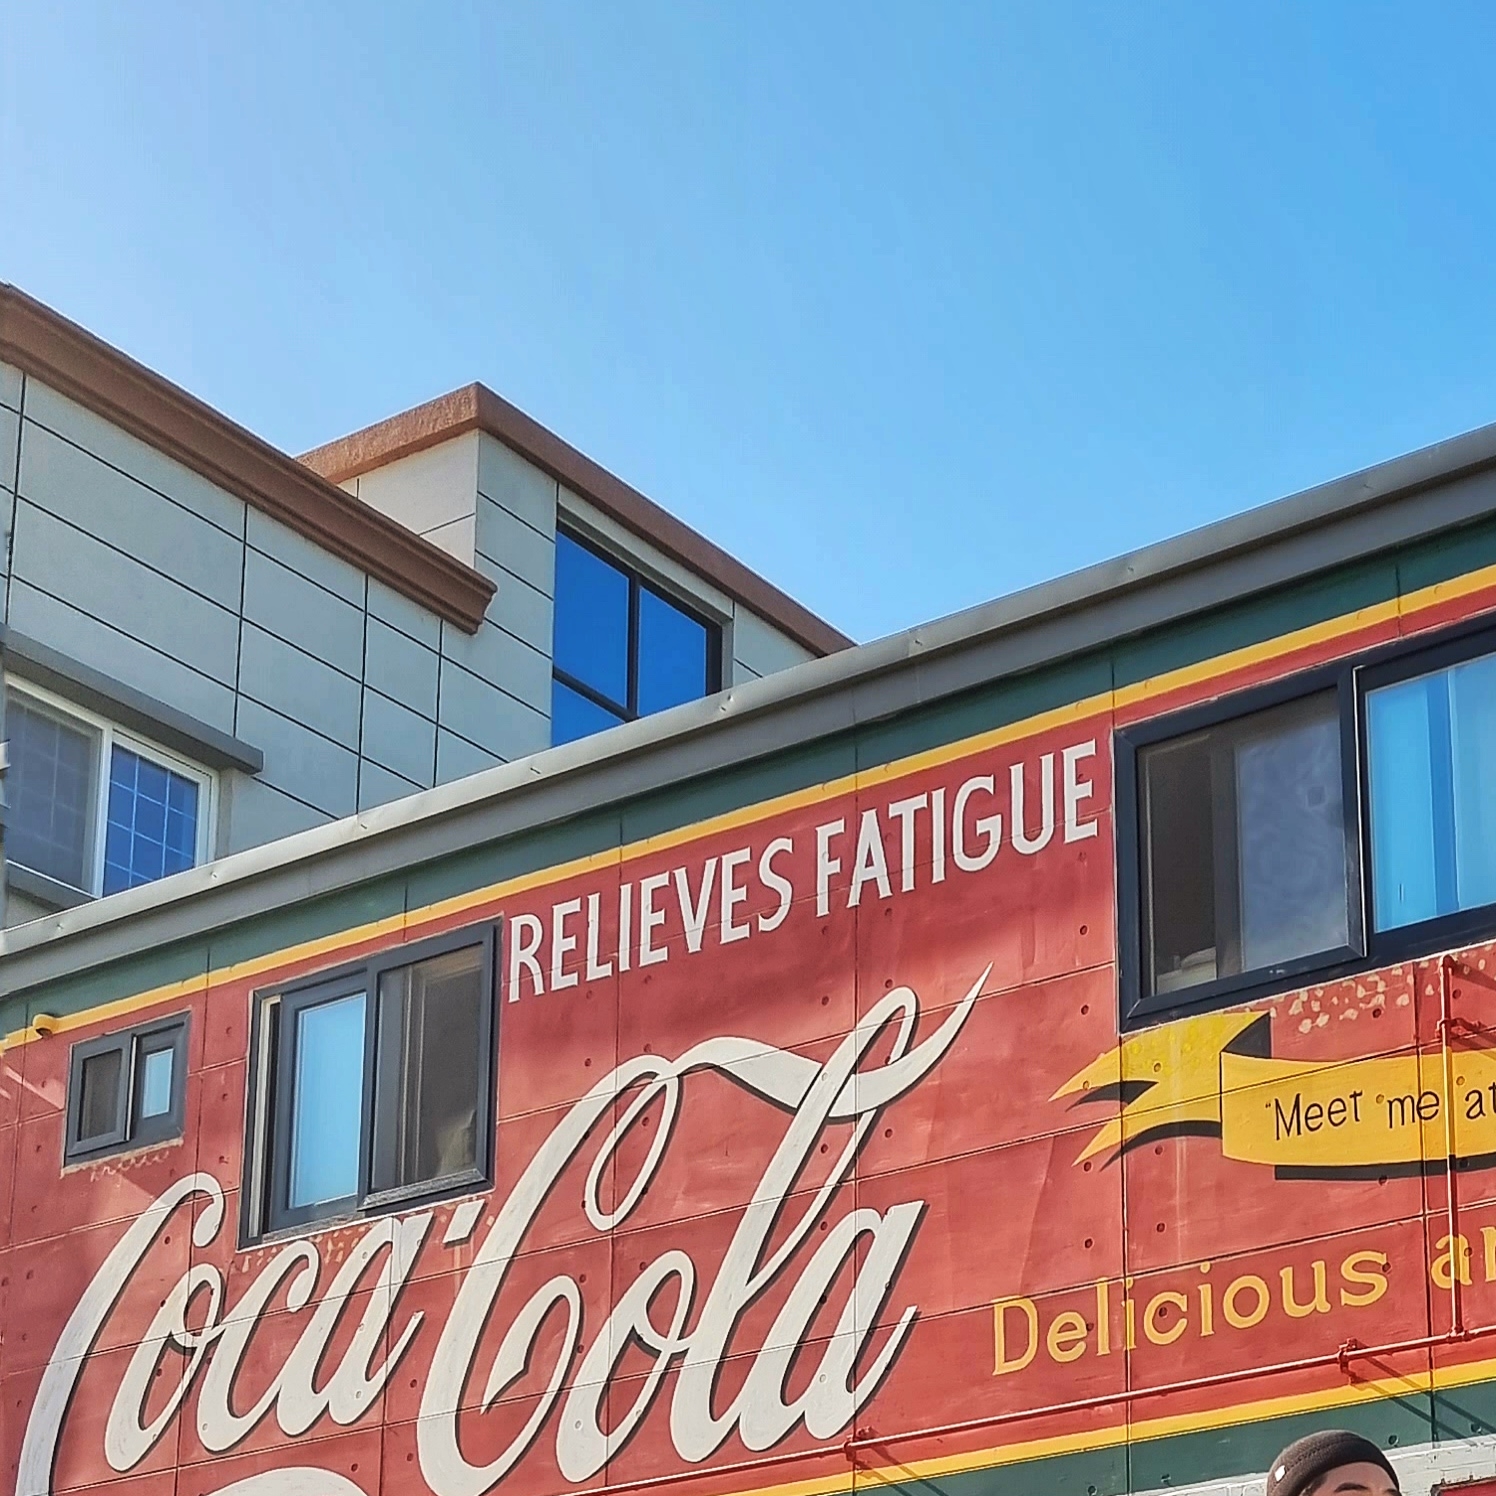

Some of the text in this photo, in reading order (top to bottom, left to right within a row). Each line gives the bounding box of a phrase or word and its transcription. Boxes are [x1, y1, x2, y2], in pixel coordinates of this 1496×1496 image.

[507, 738, 1098, 1003] RELIEVES FATIGUE
[1387, 1090, 1440, 1129] me
[991, 1249, 1390, 1376] Delicious
